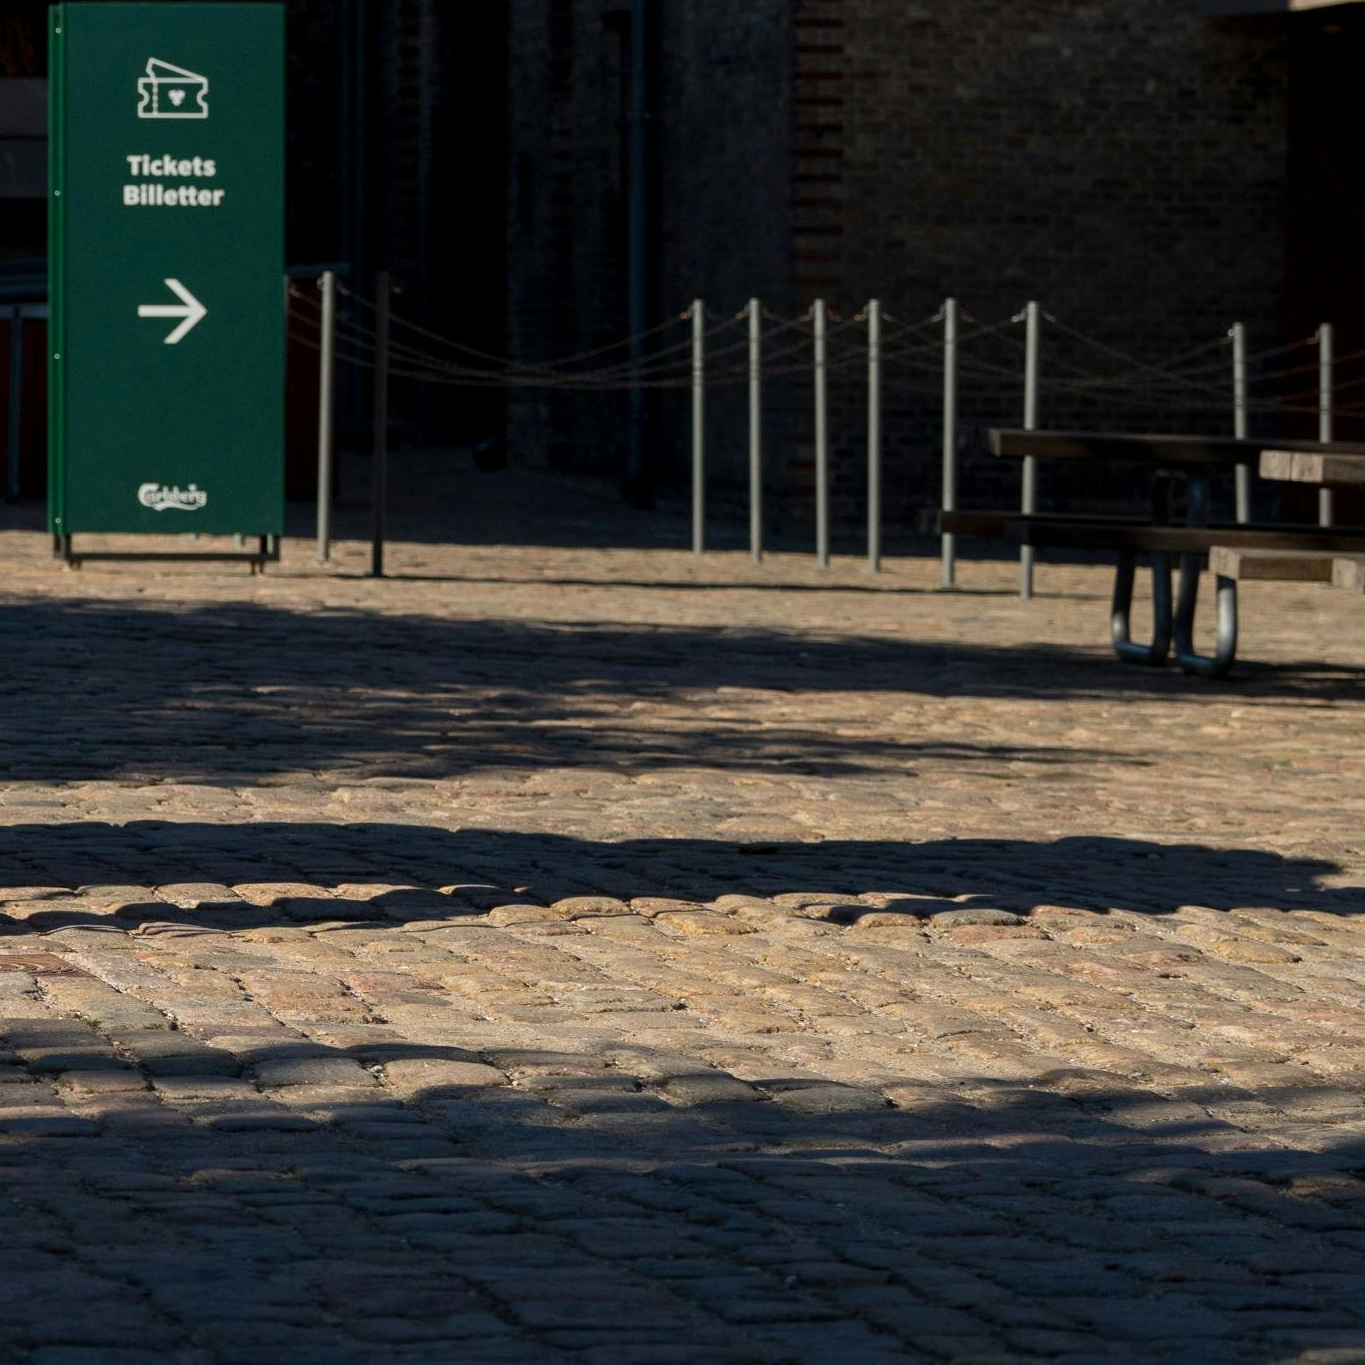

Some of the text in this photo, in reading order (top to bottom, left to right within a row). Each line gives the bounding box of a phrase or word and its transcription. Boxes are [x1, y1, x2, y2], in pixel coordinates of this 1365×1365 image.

[126, 153, 217, 177] Tickets
[122, 182, 226, 207] Billetter
[137, 482, 208, 512] Carlsberg
